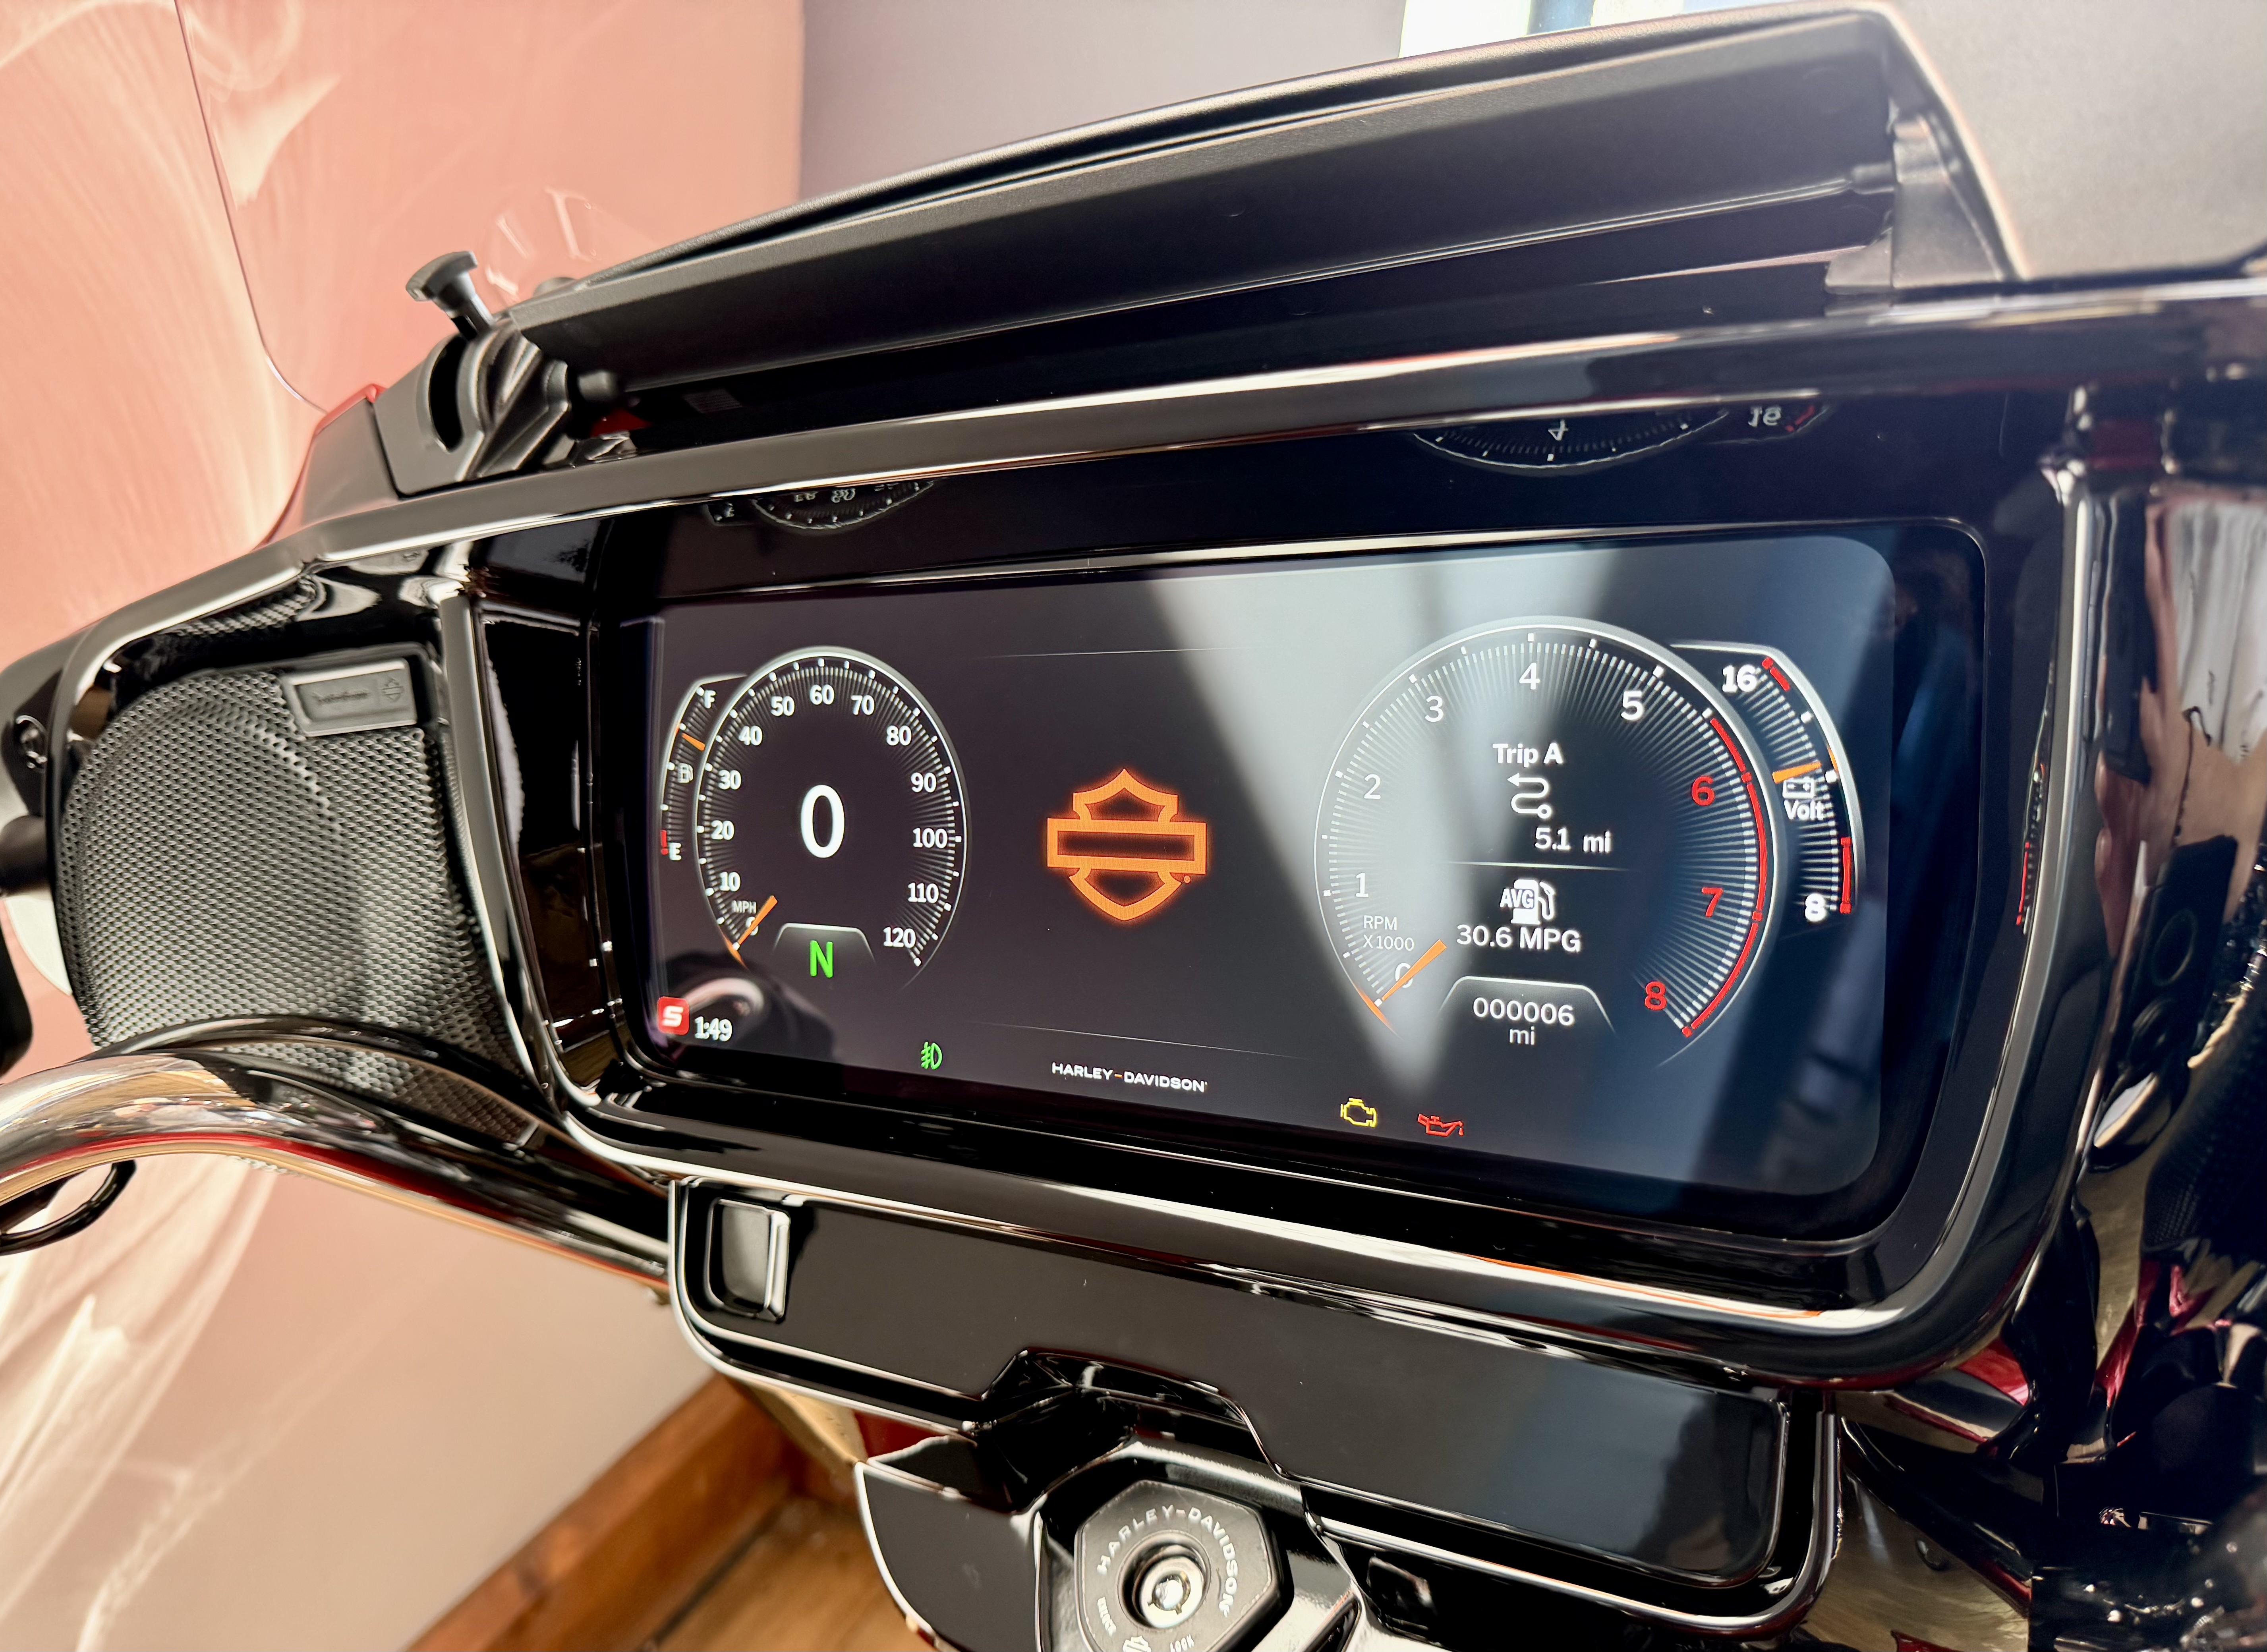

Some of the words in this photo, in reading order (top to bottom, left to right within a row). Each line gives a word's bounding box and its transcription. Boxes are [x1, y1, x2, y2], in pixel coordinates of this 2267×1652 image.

[1519, 663, 1540, 690] 4
[1722, 665, 1758, 692] 16
[704, 690, 716, 709] F
[810, 684, 835, 705] 60
[851, 695, 875, 716] 70
[1621, 691, 1644, 721] 5
[771, 696, 795, 717] 50
[1424, 696, 1444, 722] 3
[739, 725, 763, 746] 40
[886, 725, 912, 746] 80
[1492, 743, 1538, 767] Trip
[1544, 742, 1564, 765] A
[719, 770, 742, 790] 30
[911, 772, 937, 793] 90
[1364, 774, 1381, 799] 2
[1691, 776, 1715, 806] 6
[800, 784, 845, 859] 0
[1784, 800, 1825, 820] Volt
[711, 820, 734, 840] 20
[912, 827, 948, 848] 100
[1535, 827, 1571, 850] 5.1
[1583, 831, 1612, 853] mi
[669, 842, 682, 861] E
[719, 871, 741, 893] 10
[908, 882, 939, 904] 110
[1355, 872, 1369, 898] 1
[731, 900, 756, 914] MPH
[1500, 887, 1535, 909] AVG
[1701, 887, 1724, 917] 7
[1804, 893, 1827, 922] 8
[1363, 915, 1397, 931] RPM
[883, 927, 916, 948] 120
[1456, 924, 1512, 947] 30.6
[1519, 927, 1581, 953] MPG
[810, 940, 833, 978] N
[1645, 981, 1667, 1011] 8
[1473, 997, 1575, 1026] 000006
[695, 1016, 732, 1042] 1:49
[1509, 1026, 1536, 1045] mi
[1052, 1062, 1208, 1092] HARLEY-DAVIDSON
[1097, 1505, 1238, 1617] HARLEY-DAVIDSON
